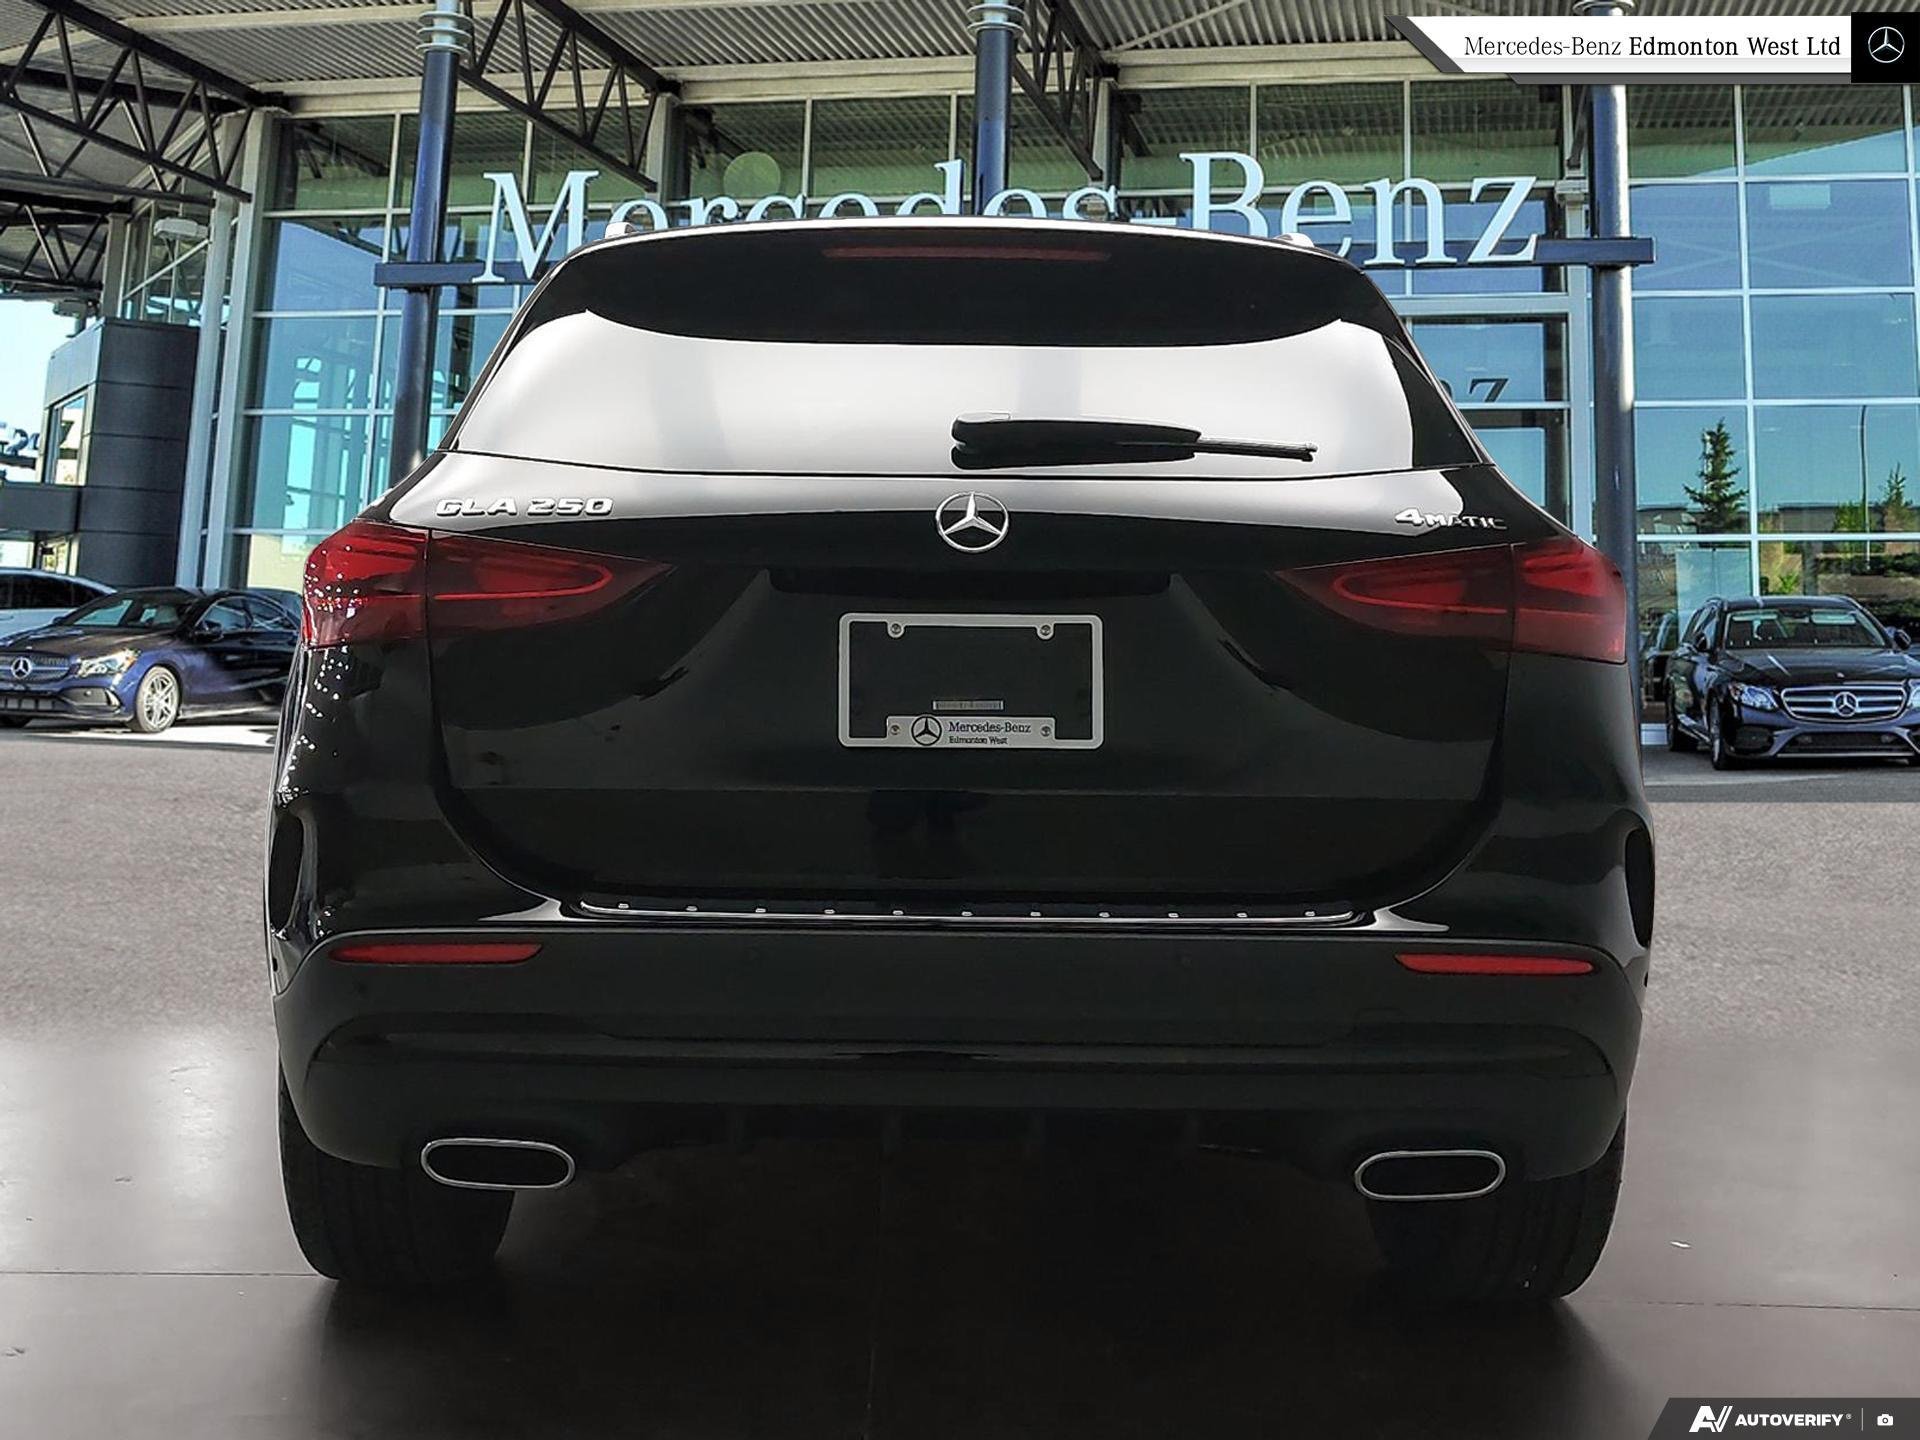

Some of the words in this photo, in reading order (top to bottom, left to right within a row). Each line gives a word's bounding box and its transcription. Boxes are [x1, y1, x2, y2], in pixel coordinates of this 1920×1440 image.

[436, 498, 518, 516] GLA
[526, 498, 615, 516] 250
[1395, 508, 1508, 530] 4MATIC
[948, 721, 1032, 733] Mercedes-Benz
[948, 735, 988, 745] Edmonton
